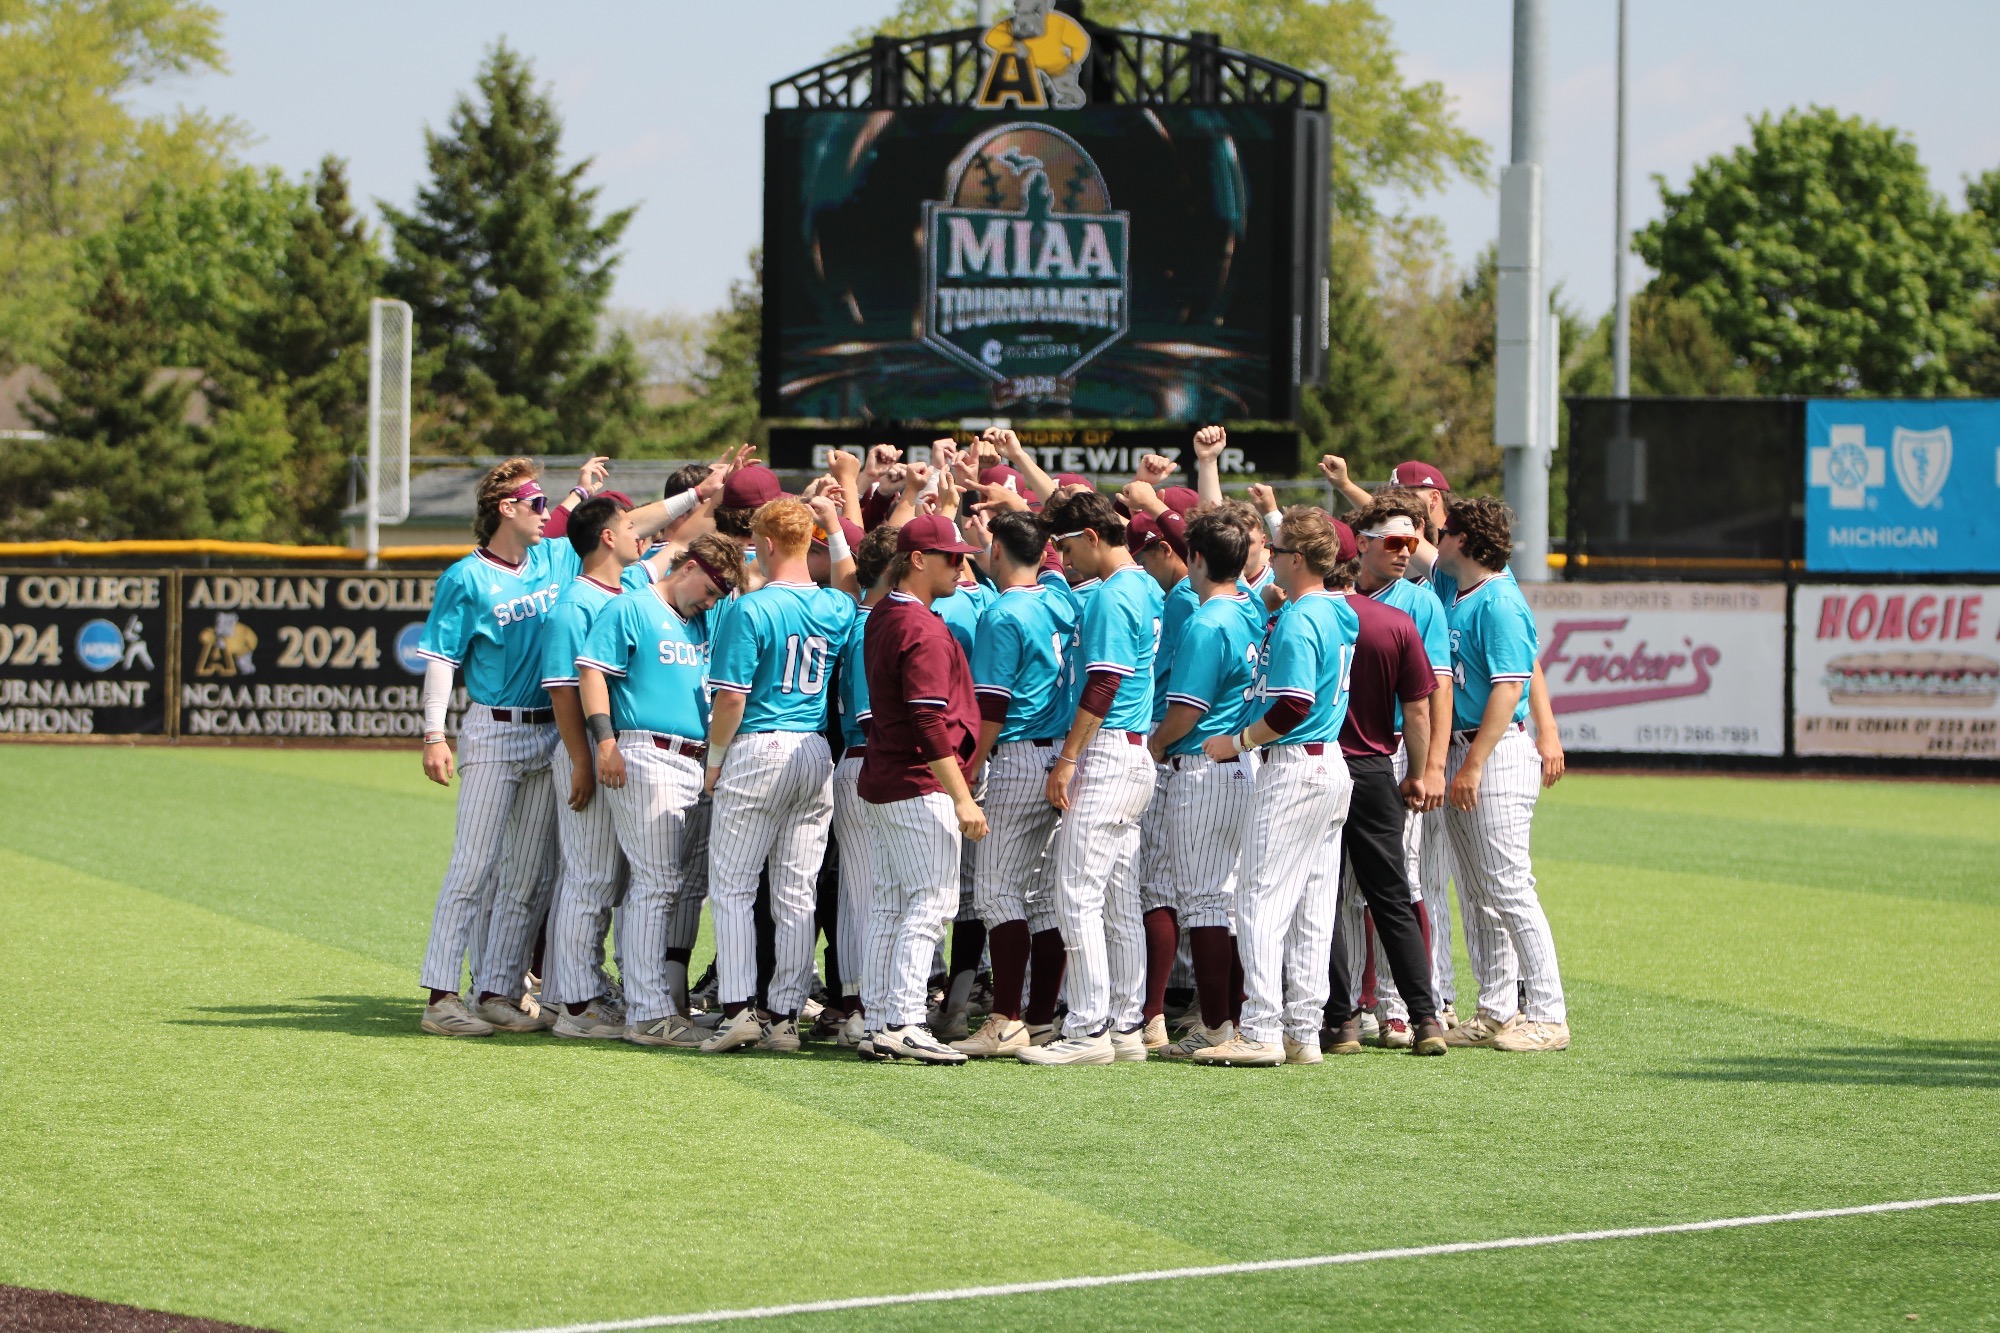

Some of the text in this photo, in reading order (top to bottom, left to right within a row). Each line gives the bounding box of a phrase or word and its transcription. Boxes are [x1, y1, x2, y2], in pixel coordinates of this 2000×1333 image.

[945, 216, 1121, 280] MIAA
[938, 286, 1123, 335] TOURNAMENT
[1082, 430, 1114, 445] OF
[1194, 447, 1256, 474] R.
[1829, 526, 1938, 548] MICHIGAN
[17, 576, 160, 609] COLLEGE
[187, 577, 436, 611] ADRIAN COLLE
[1533, 590, 1761, 608] FOOD SPORTS SPIRITS
[1816, 593, 1984, 642] HOAGIE
[277, 625, 381, 669] 2024
[780, 632, 828, 696] 10
[182, 683, 254, 708] NCAA
[254, 684, 381, 711] REGIONAL
[189, 708, 262, 734] NCAA
[262, 710, 336, 736] SUPER
